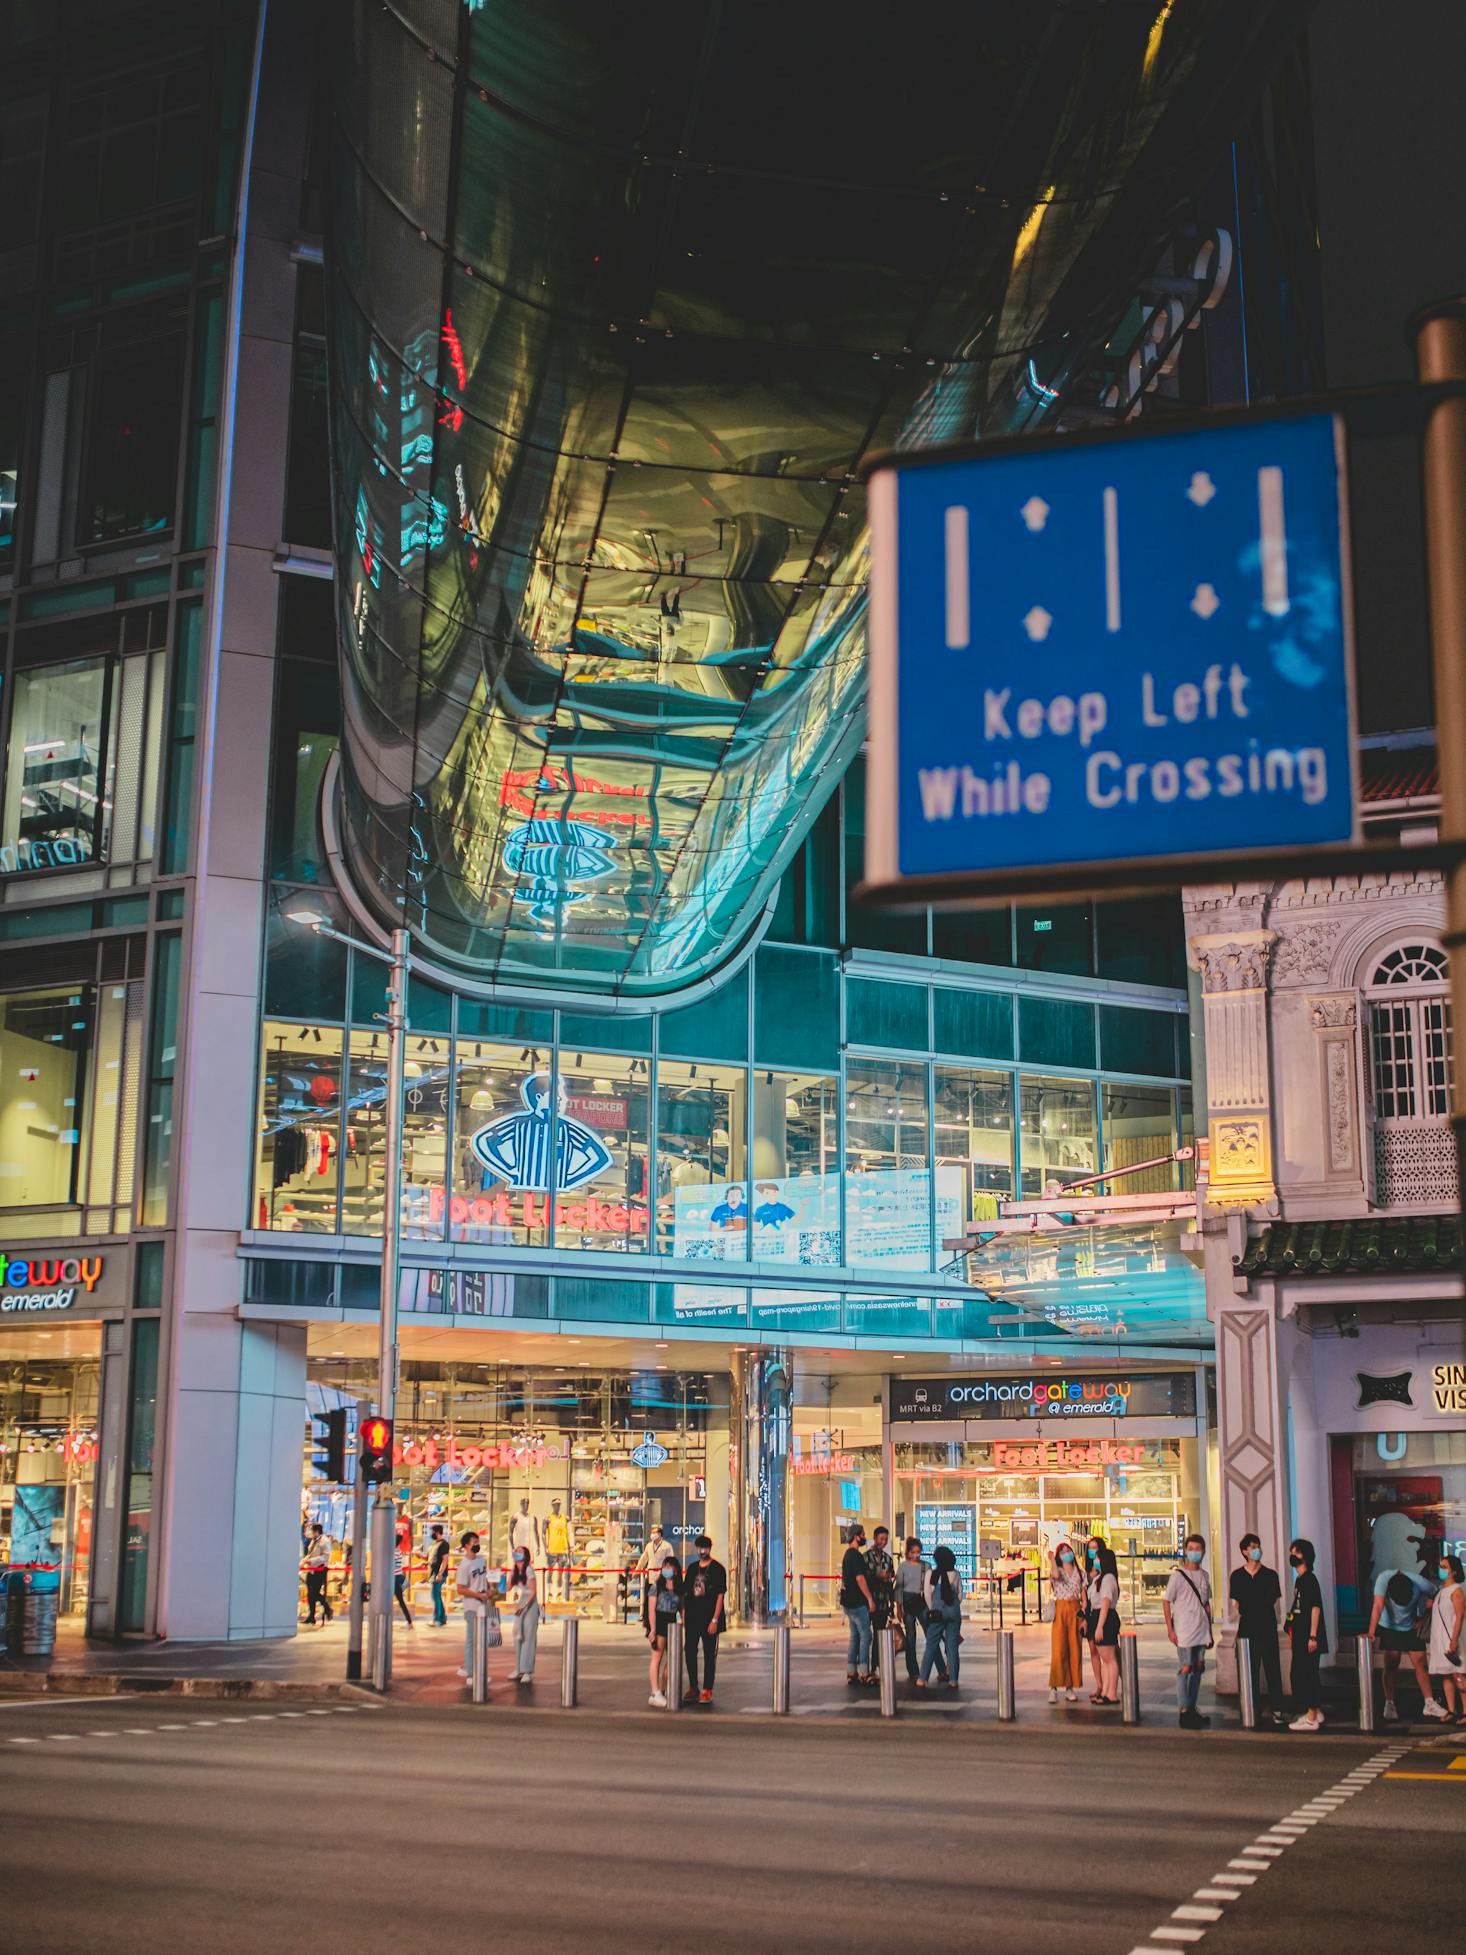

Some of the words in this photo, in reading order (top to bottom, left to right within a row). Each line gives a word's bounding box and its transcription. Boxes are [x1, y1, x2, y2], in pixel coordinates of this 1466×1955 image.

[984, 687, 1107, 748] Keep
[1142, 663, 1251, 727] Left
[918, 760, 1051, 822] While
[1086, 738, 1328, 809] Crossing
[582, 1100, 624, 1112] LOCKER
[429, 1187, 513, 1225] Foot
[523, 1192, 649, 1233] Locker
[0, 1288, 76, 1312] emerald
[1434, 1365, 1466, 1386] SIN
[950, 1380, 1131, 1404] orchardgateway
[900, 1404, 917, 1413] MRT
[919, 1403, 931, 1413] via
[932, 1403, 942, 1412] B2
[1063, 1401, 1113, 1413] emerald
[447, 1440, 545, 1468] Locker
[994, 1440, 1050, 1467] Foot
[1056, 1440, 1145, 1466] Locker
[920, 1510, 936, 1518] NEW
[937, 1510, 972, 1518] ARRIVALS
[920, 1524, 936, 1532] NEW
